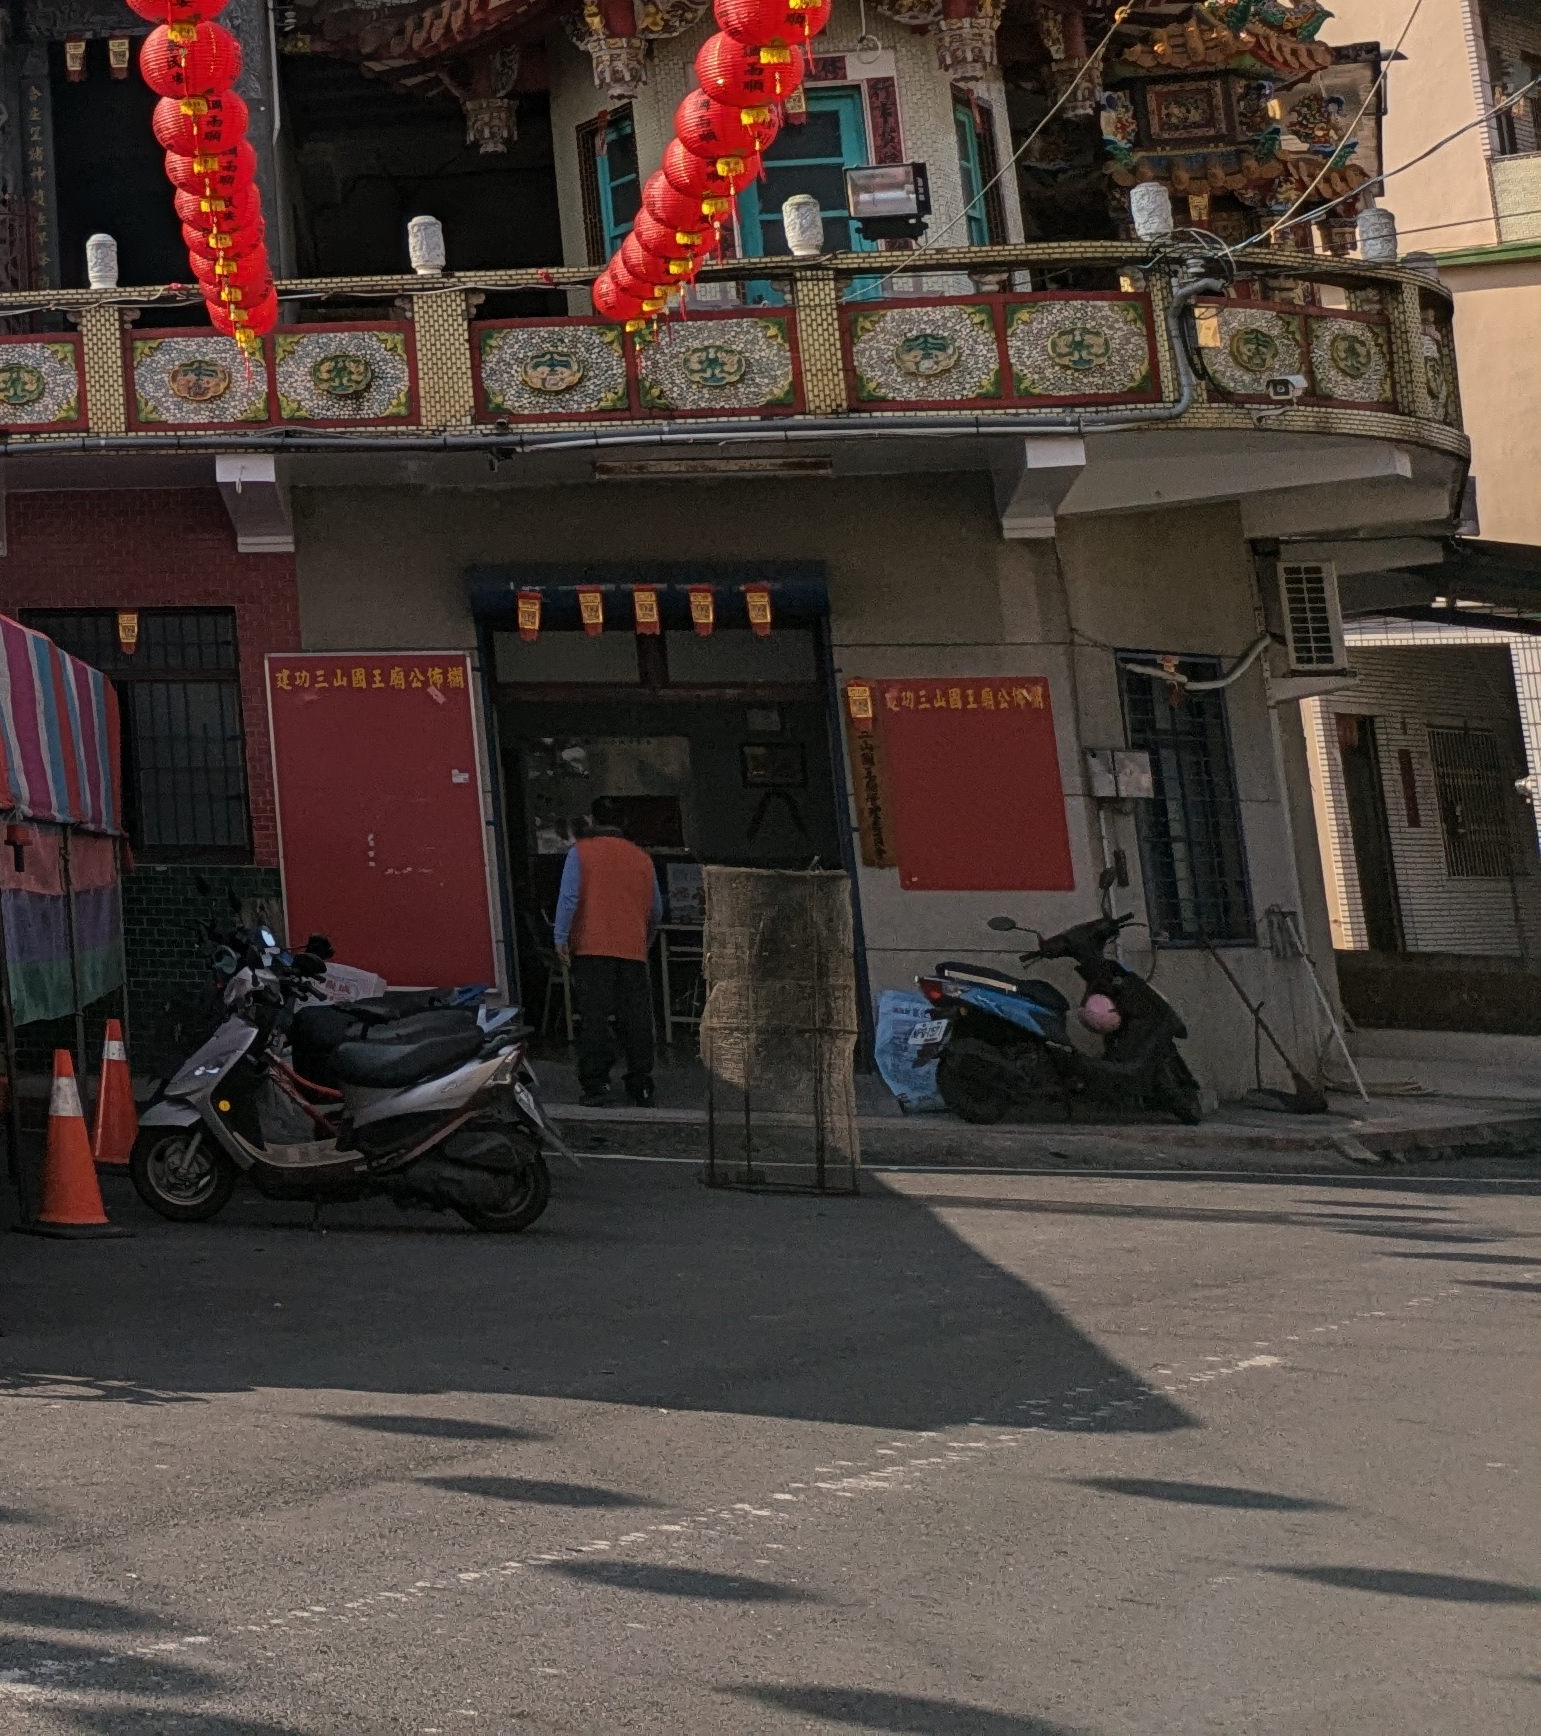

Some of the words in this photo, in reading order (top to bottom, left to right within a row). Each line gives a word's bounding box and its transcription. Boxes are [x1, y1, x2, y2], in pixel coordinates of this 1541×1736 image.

[204, 98, 224, 143] 調雨順
[275, 666, 465, 690] 建功三山國王廟公佈欄
